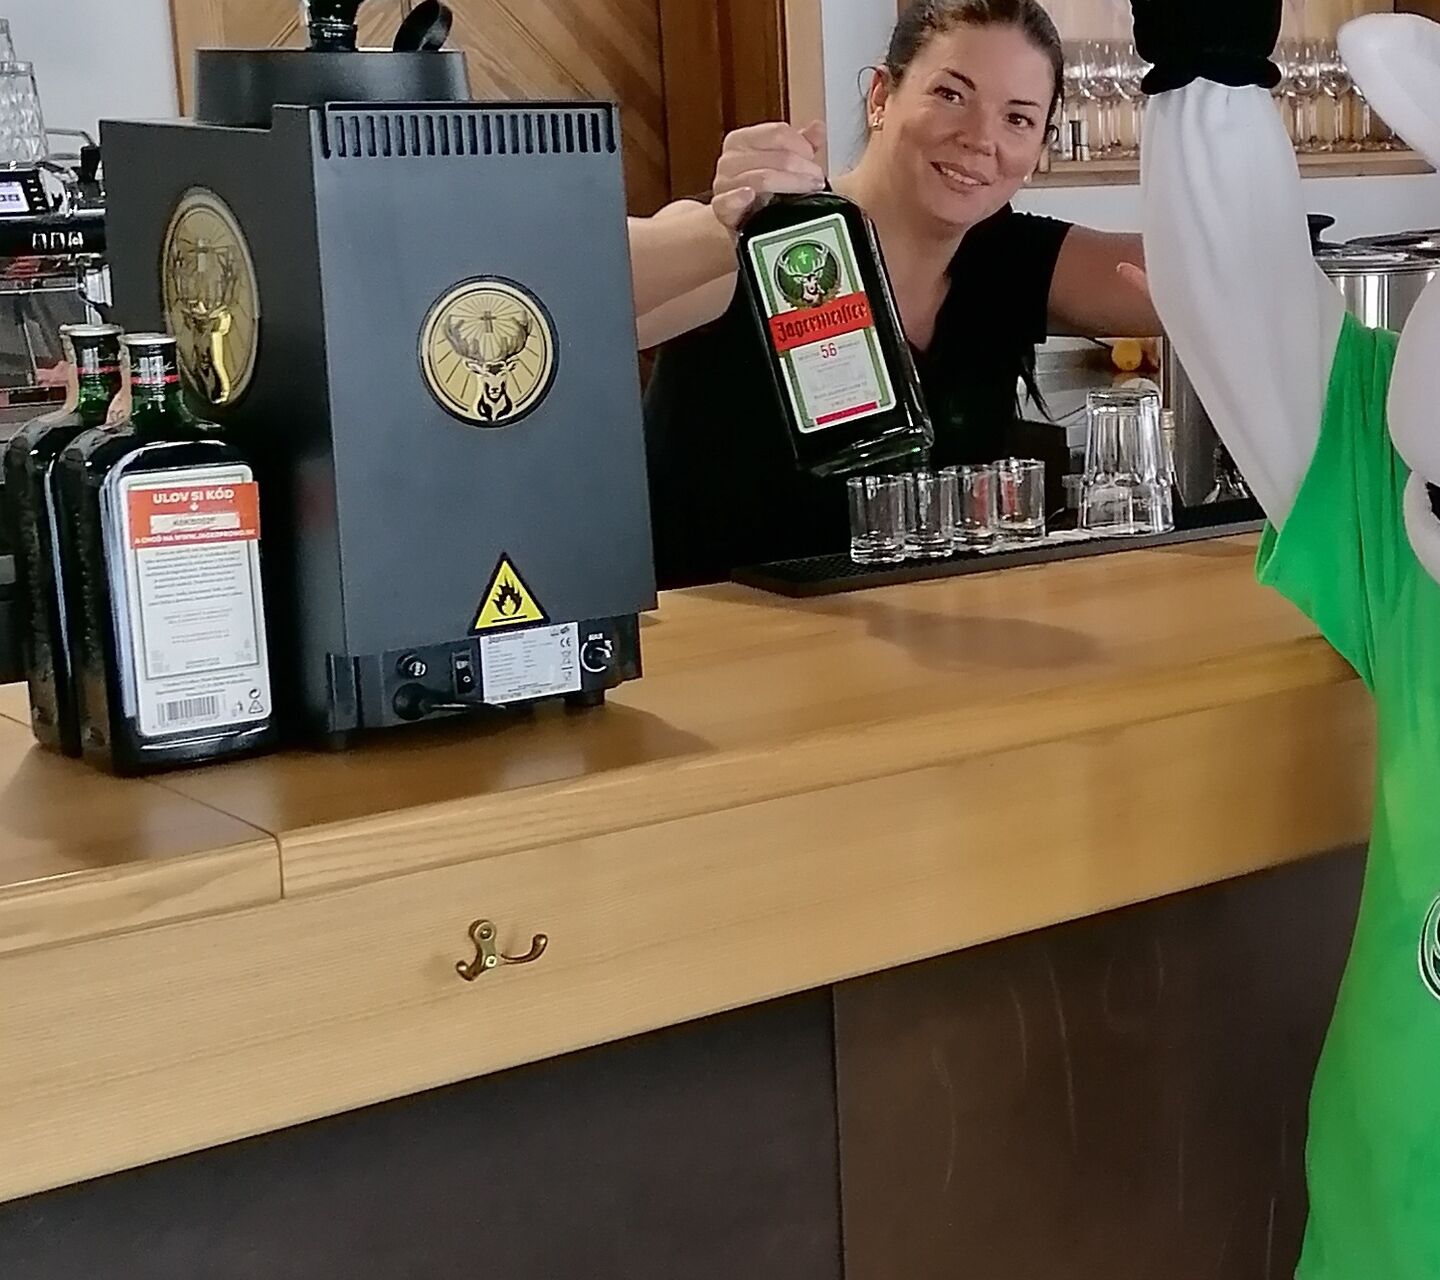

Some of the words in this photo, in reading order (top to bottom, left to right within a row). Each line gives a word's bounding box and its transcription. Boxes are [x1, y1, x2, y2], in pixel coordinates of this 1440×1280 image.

[820, 342, 838, 359] 56
[153, 491, 189, 504] ULOV
[190, 490, 204, 501] SI
[206, 487, 235, 500] KÓD
